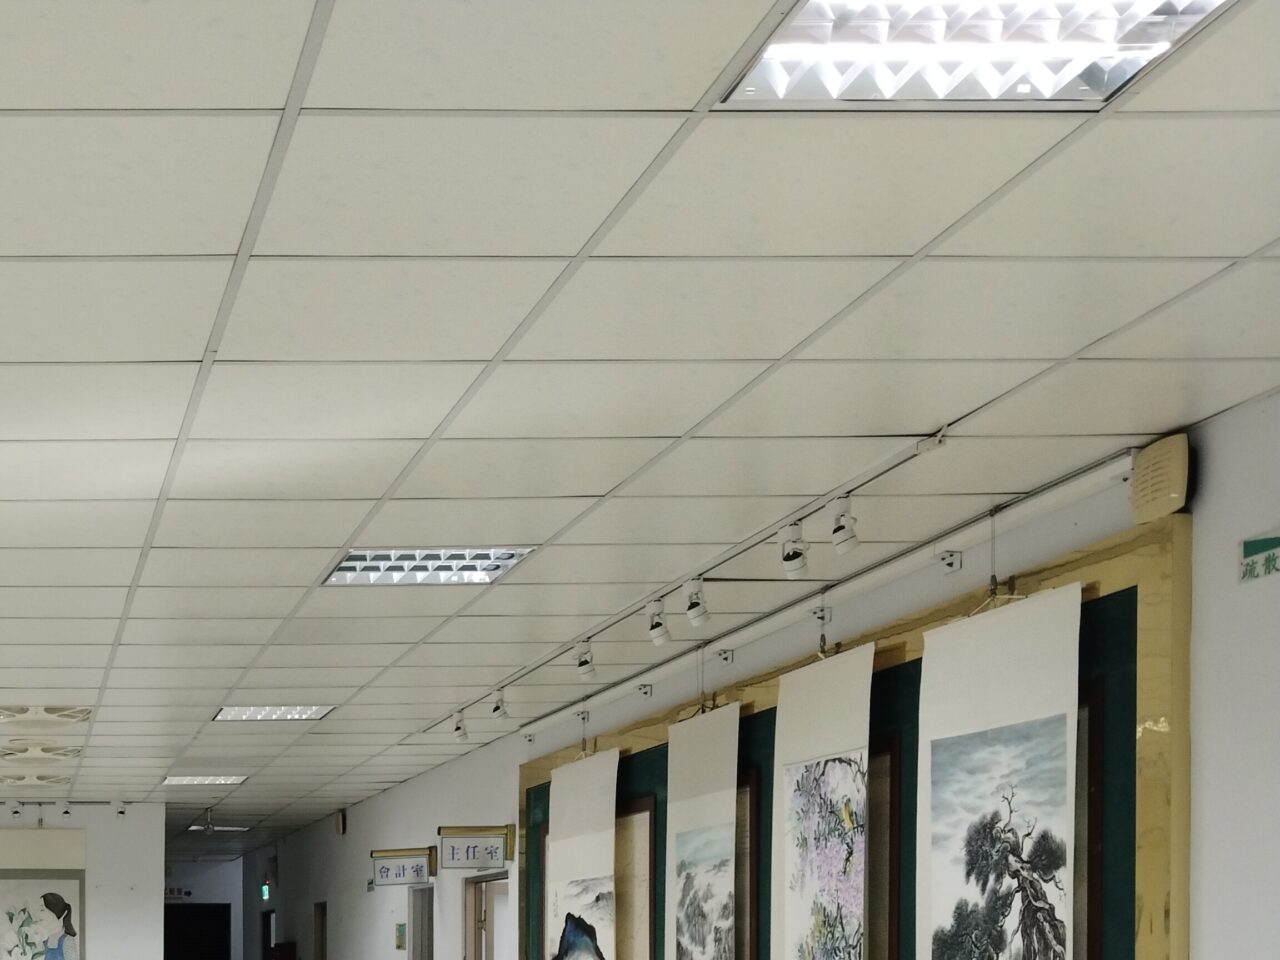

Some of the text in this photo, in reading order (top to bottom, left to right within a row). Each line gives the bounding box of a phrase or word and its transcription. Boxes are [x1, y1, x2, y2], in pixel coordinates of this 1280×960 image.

[449, 844, 500, 861] 主任室
[379, 864, 424, 879] 會計室
